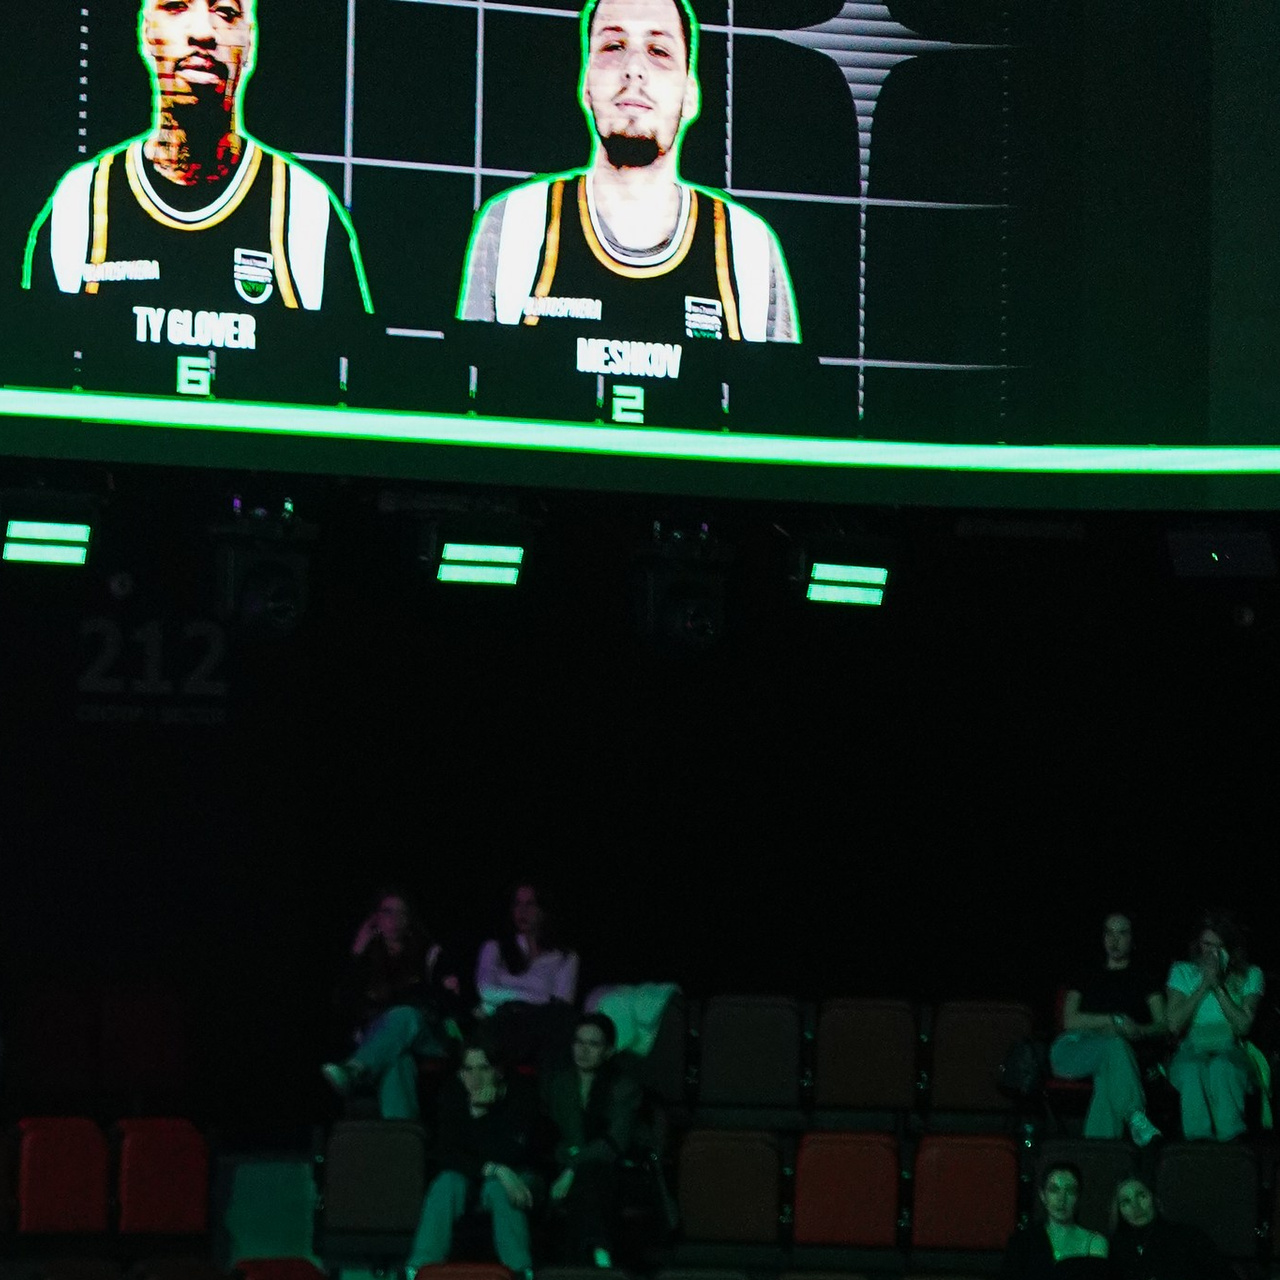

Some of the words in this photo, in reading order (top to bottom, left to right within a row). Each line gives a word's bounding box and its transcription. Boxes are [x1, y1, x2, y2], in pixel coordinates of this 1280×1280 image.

[132, 305, 166, 343] TY
[167, 308, 257, 350] GLOVER
[176, 355, 211, 395] 6
[576, 337, 683, 379] MESHKOV
[612, 384, 644, 424] 2
[76, 615, 231, 696] 212
